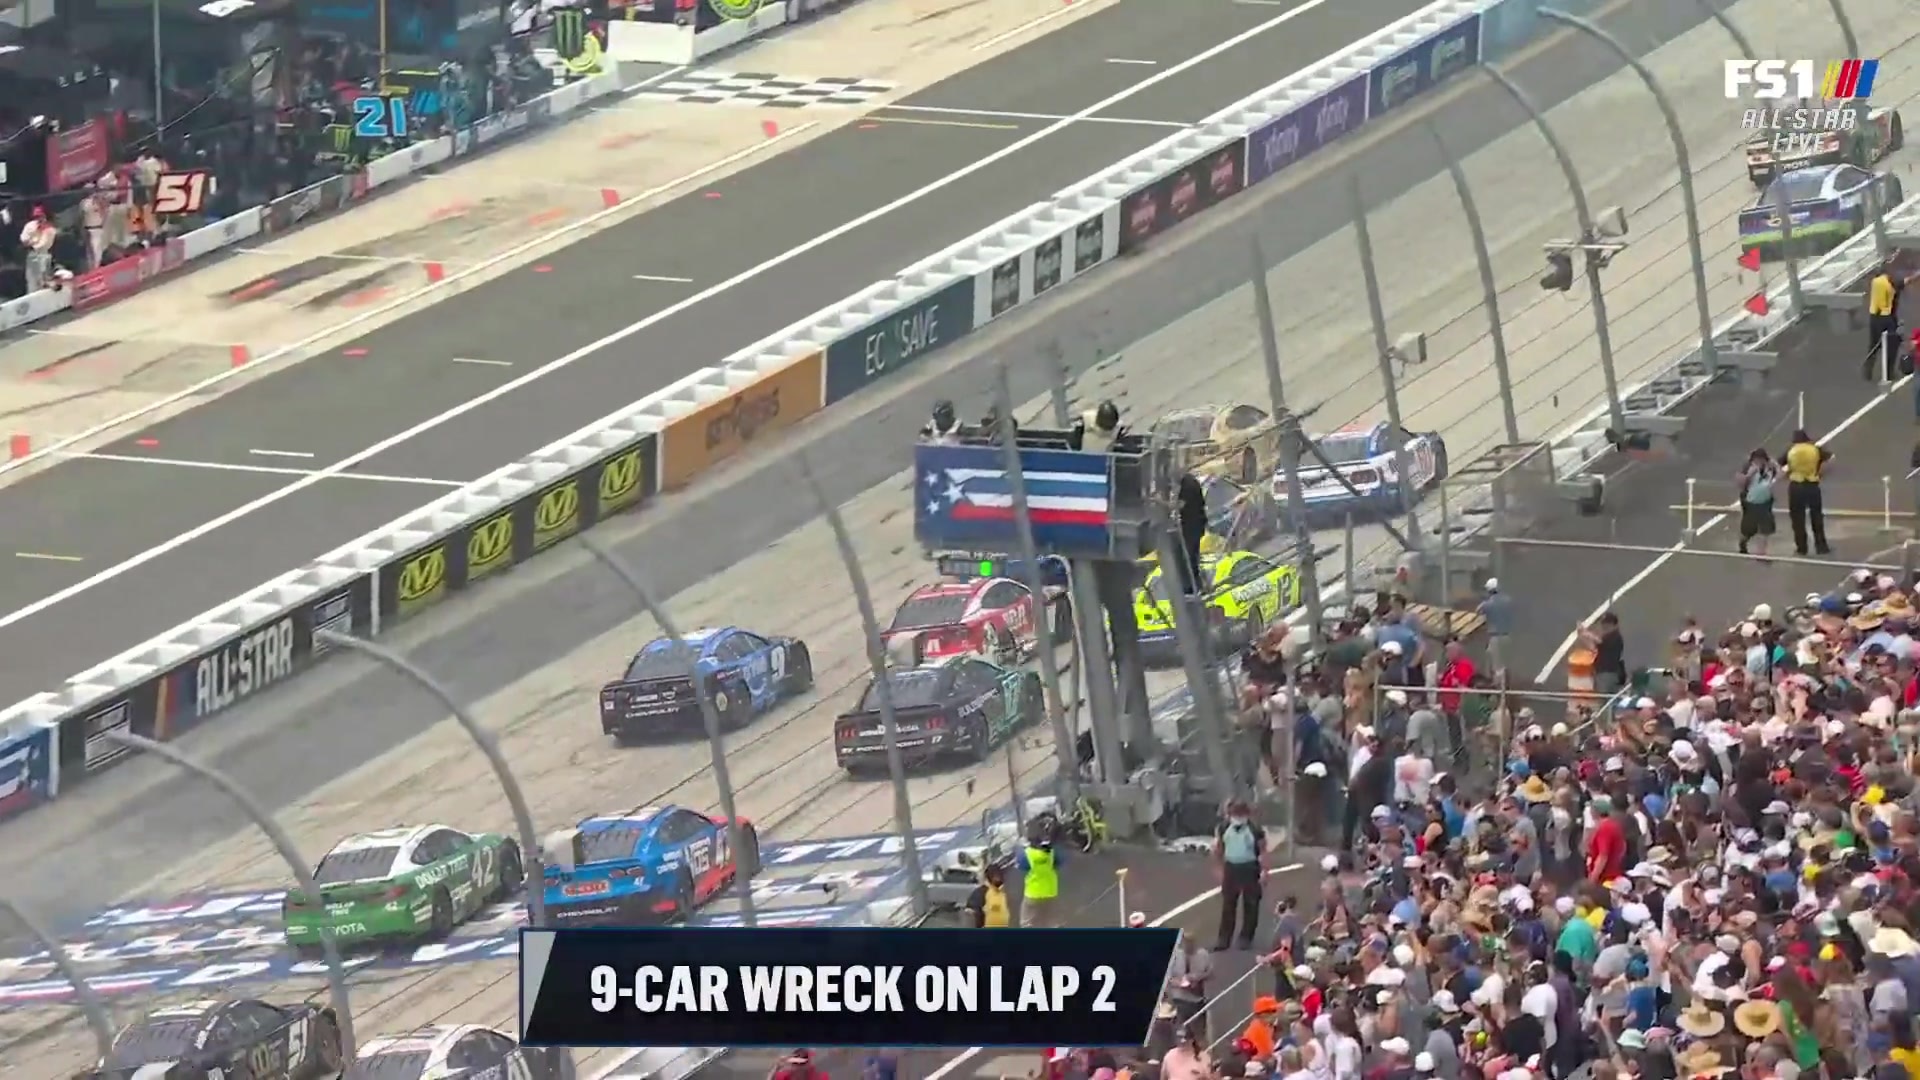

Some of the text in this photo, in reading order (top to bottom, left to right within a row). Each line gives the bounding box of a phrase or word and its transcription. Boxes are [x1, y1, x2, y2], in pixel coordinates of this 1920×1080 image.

[353, 96, 407, 137] 21
[154, 172, 206, 213] 51
[770, 645, 786, 683] 9
[472, 845, 495, 889] 42
